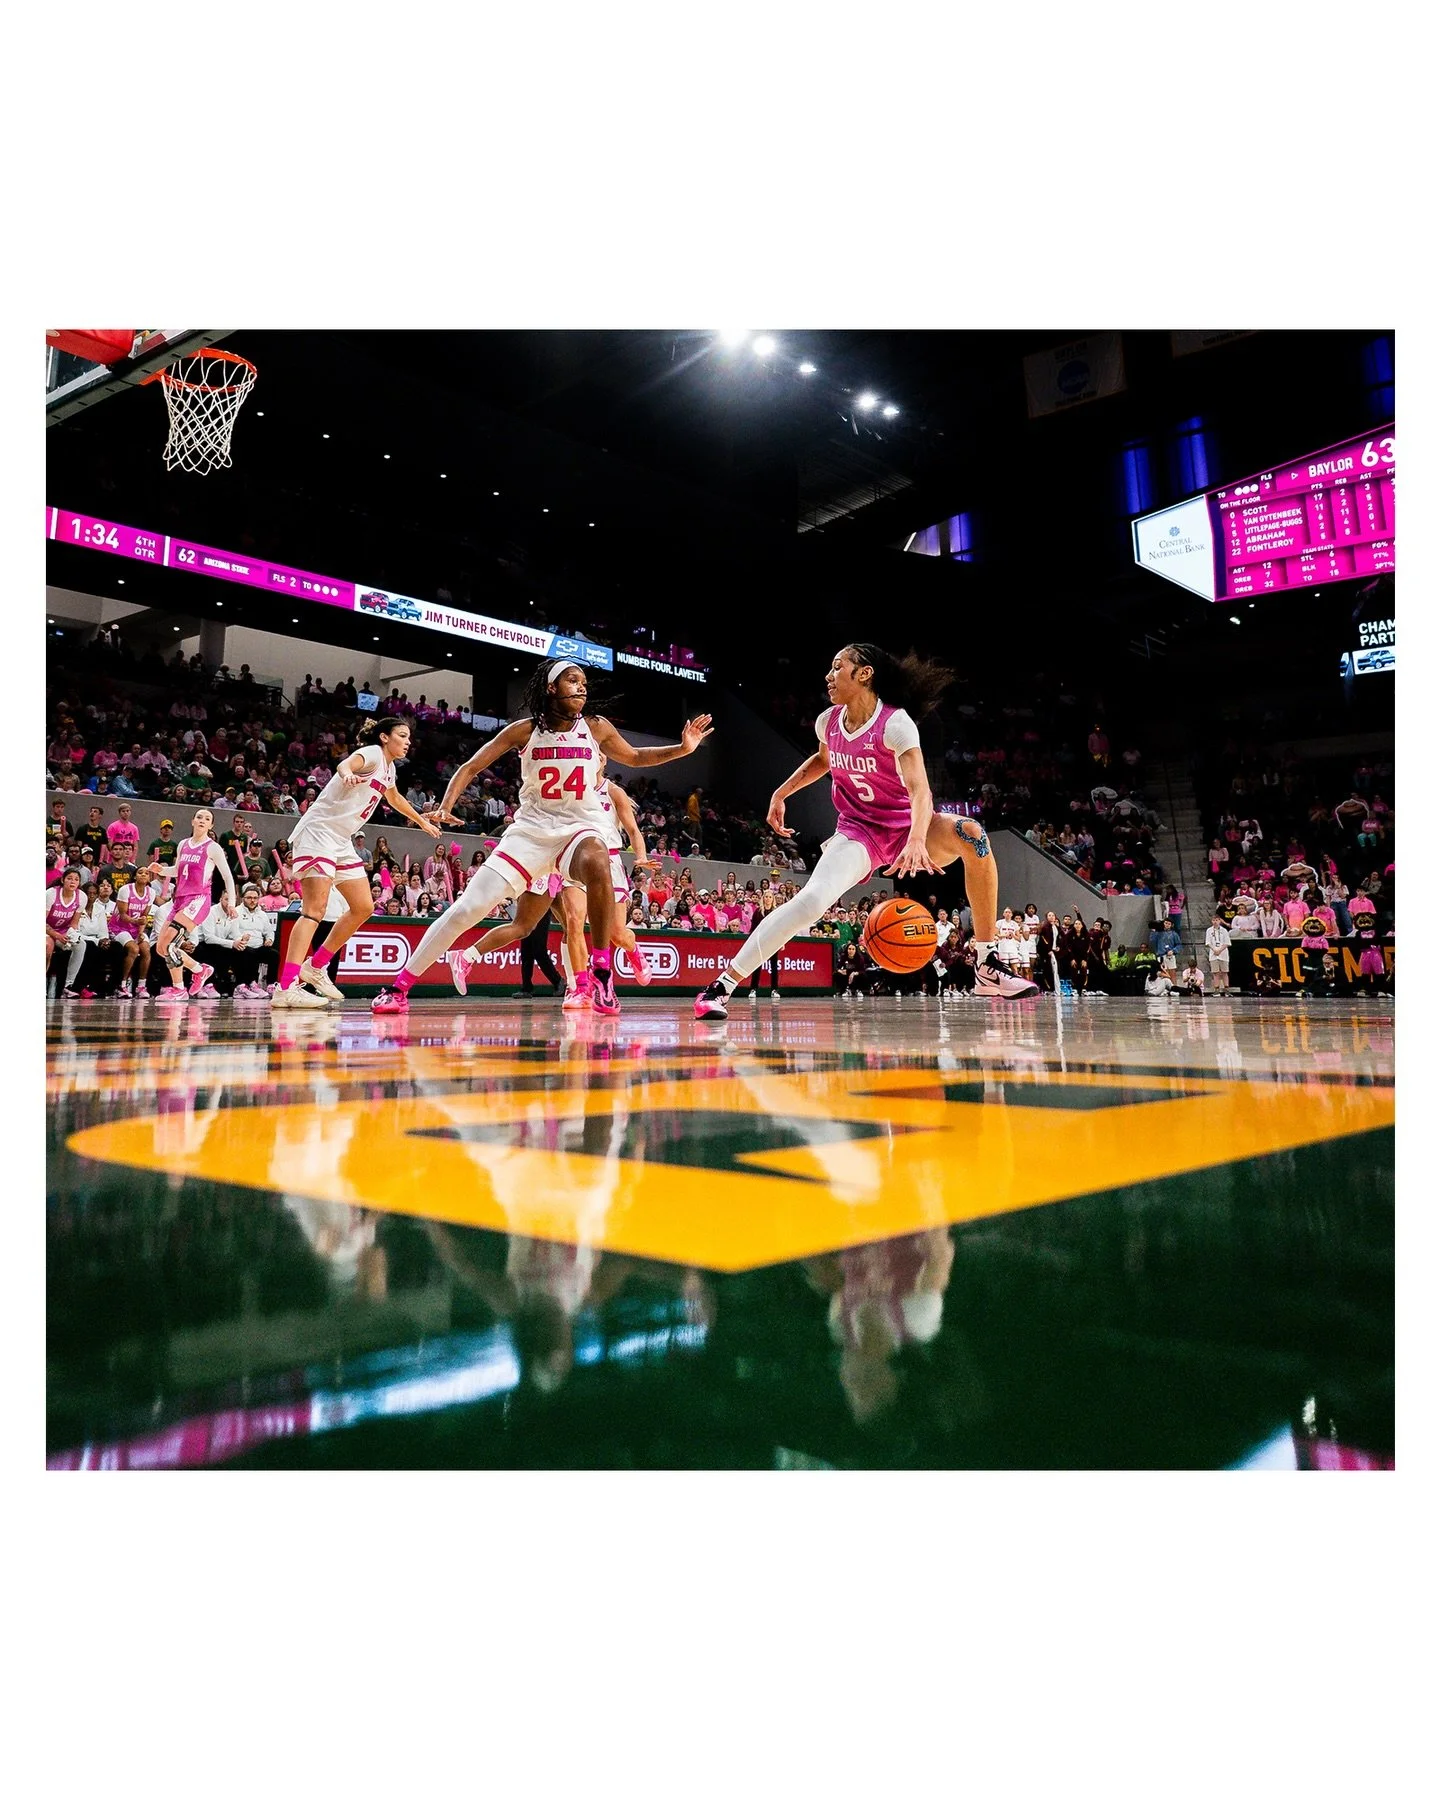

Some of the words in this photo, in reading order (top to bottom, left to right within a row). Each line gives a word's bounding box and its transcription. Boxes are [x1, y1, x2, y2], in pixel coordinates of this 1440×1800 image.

[1308, 457, 1354, 478] BAYLOR
[1361, 438, 1395, 467] 63
[1260, 473, 1273, 481] FLS
[1334, 477, 1347, 485] REB
[1359, 472, 1372, 480] AST
[1217, 491, 1226, 499] TO
[1229, 511, 1236, 520] 0
[1242, 505, 1268, 517] SCOTT
[1313, 493, 1323, 501] 17
[1340, 488, 1346, 496] 2
[1364, 483, 1371, 491] 3
[1241, 495, 1261, 505] FLOOR
[1314, 503, 1324, 511] 11
[1341, 499, 1347, 507] 2
[1340, 508, 1350, 516] 11
[1367, 502, 1373, 511] 2
[71, 518, 119, 549] 1:34
[135, 535, 156, 548] 4TH
[1231, 538, 1241, 547] 12
[1245, 530, 1286, 545] ABRAHAM
[1319, 522, 1325, 530] 2
[134, 547, 155, 559] QTR
[1149, 548, 1184, 560] NATIONAL
[1185, 544, 1205, 553] BANK
[1231, 548, 1242, 556] 22
[1246, 538, 1294, 553] FONTLEROY
[178, 548, 196, 565] 62
[272, 573, 286, 583] FLS
[289, 576, 297, 588] 2
[303, 580, 312, 590] TO
[1232, 567, 1246, 575] AST
[425, 610, 443, 624] JIM
[445, 615, 488, 635] TURNER
[489, 626, 547, 649] CHEVROLET
[617, 652, 650, 669] NUMBER
[651, 660, 674, 675] FOUR.
[531, 747, 555, 760] SUN
[556, 747, 592, 760] DEVILS
[829, 750, 878, 773] BAYLOR
[538, 766, 587, 801] 24
[848, 774, 875, 802] 5
[182, 864, 189, 880] 4
[903, 924, 936, 936] ELITE
[687, 954, 715, 969] Here
[784, 957, 816, 971] Better
